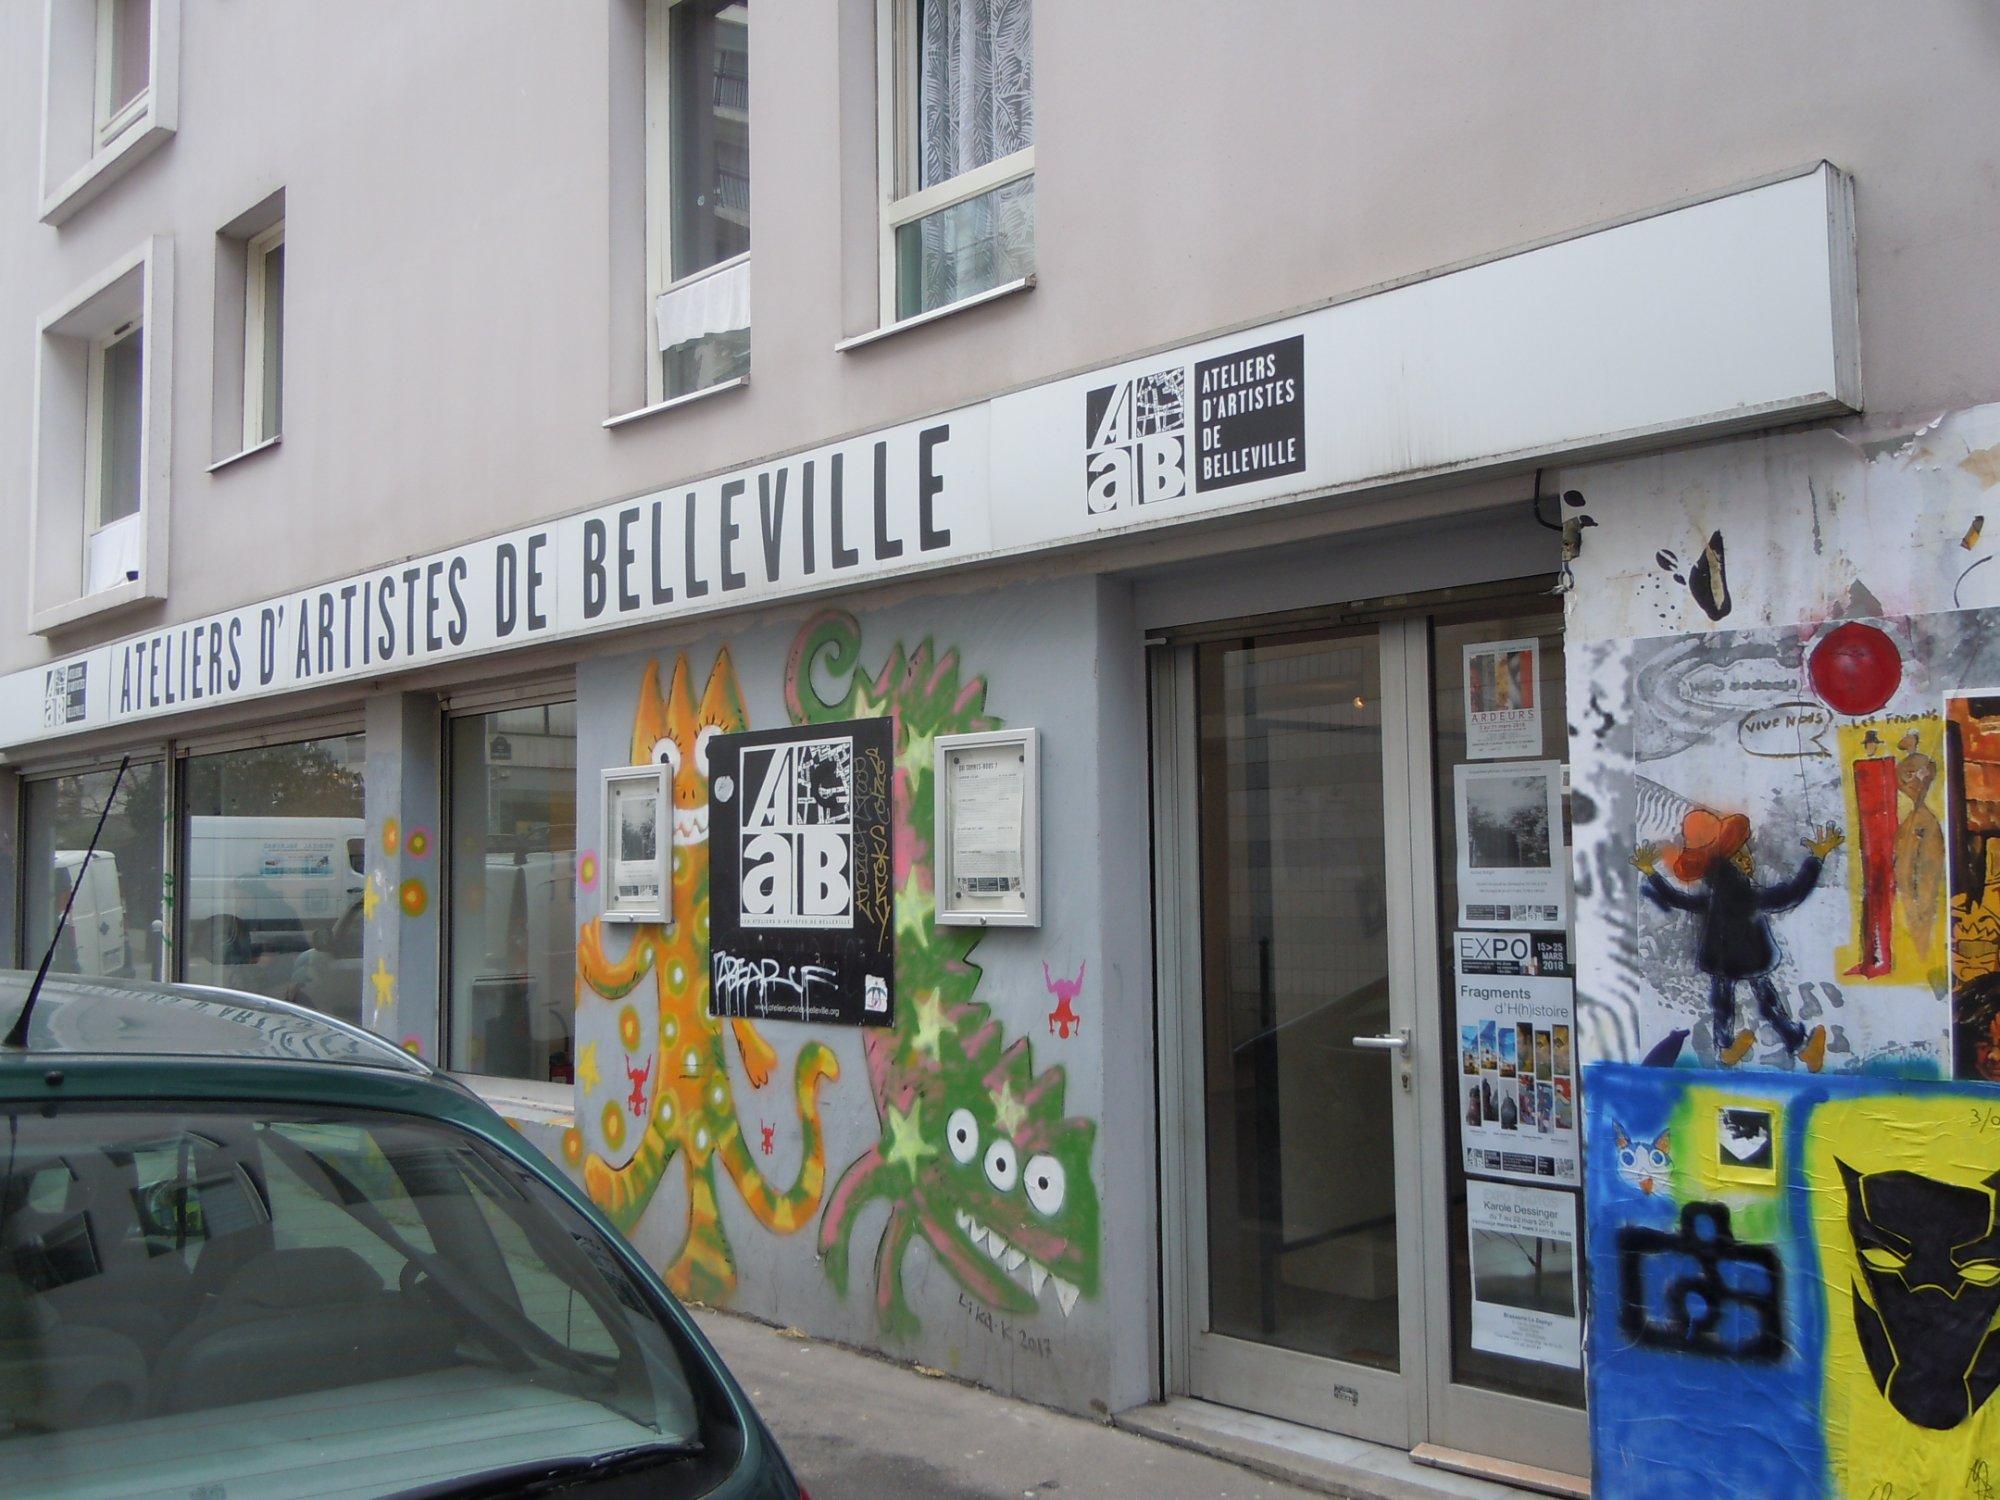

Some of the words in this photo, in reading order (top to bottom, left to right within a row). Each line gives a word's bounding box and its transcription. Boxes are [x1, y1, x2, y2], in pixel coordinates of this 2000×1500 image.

[1202, 353, 1277, 394] ATELIERS
[1202, 378, 1296, 423] D'ARTISTES
[1202, 425, 1222, 452] DE
[1203, 437, 1297, 482] BELLEVILLE
[120, 617, 242, 714] ATELIERS
[260, 555, 469, 686] D'ARTISTES
[495, 533, 548, 639] DE
[583, 424, 952, 621] BELLEVILLE
[1471, 709, 1535, 723] ARDEURS
[1460, 938, 1528, 960] EXPO
[1542, 952, 1564, 961] MARS
[1542, 961, 1564, 971] 2018
[1460, 985, 1532, 1001] Fragments
[1494, 1002, 1569, 1018] d'H(h)istoire
[1483, 1200, 1512, 1213] Karole
[1514, 1205, 1558, 1220] Dessinger
